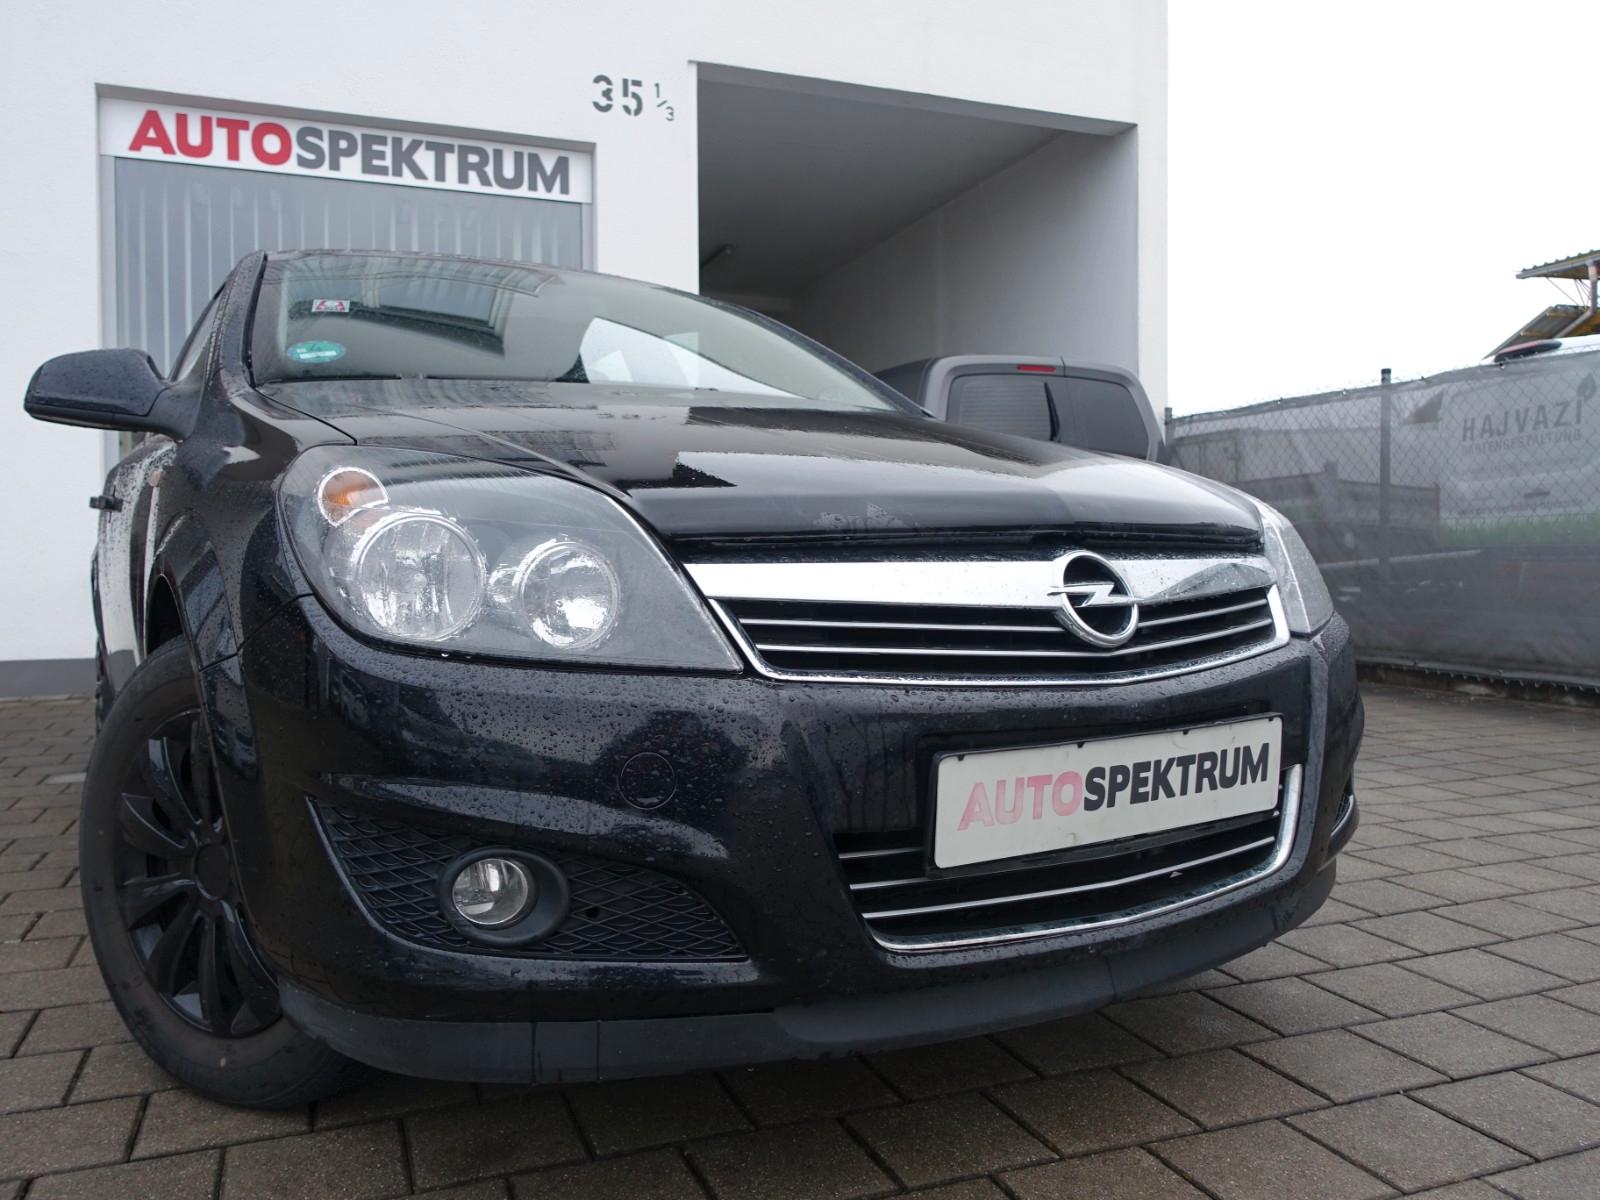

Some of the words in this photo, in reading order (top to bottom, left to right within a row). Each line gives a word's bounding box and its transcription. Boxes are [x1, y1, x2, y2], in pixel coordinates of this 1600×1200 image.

[592, 74, 643, 117] 35
[129, 109, 570, 195] AUTOSPEKTRUM
[1462, 399, 1582, 442] HAJVAZI
[957, 742, 1270, 831] AUTOSPEKTRUM
